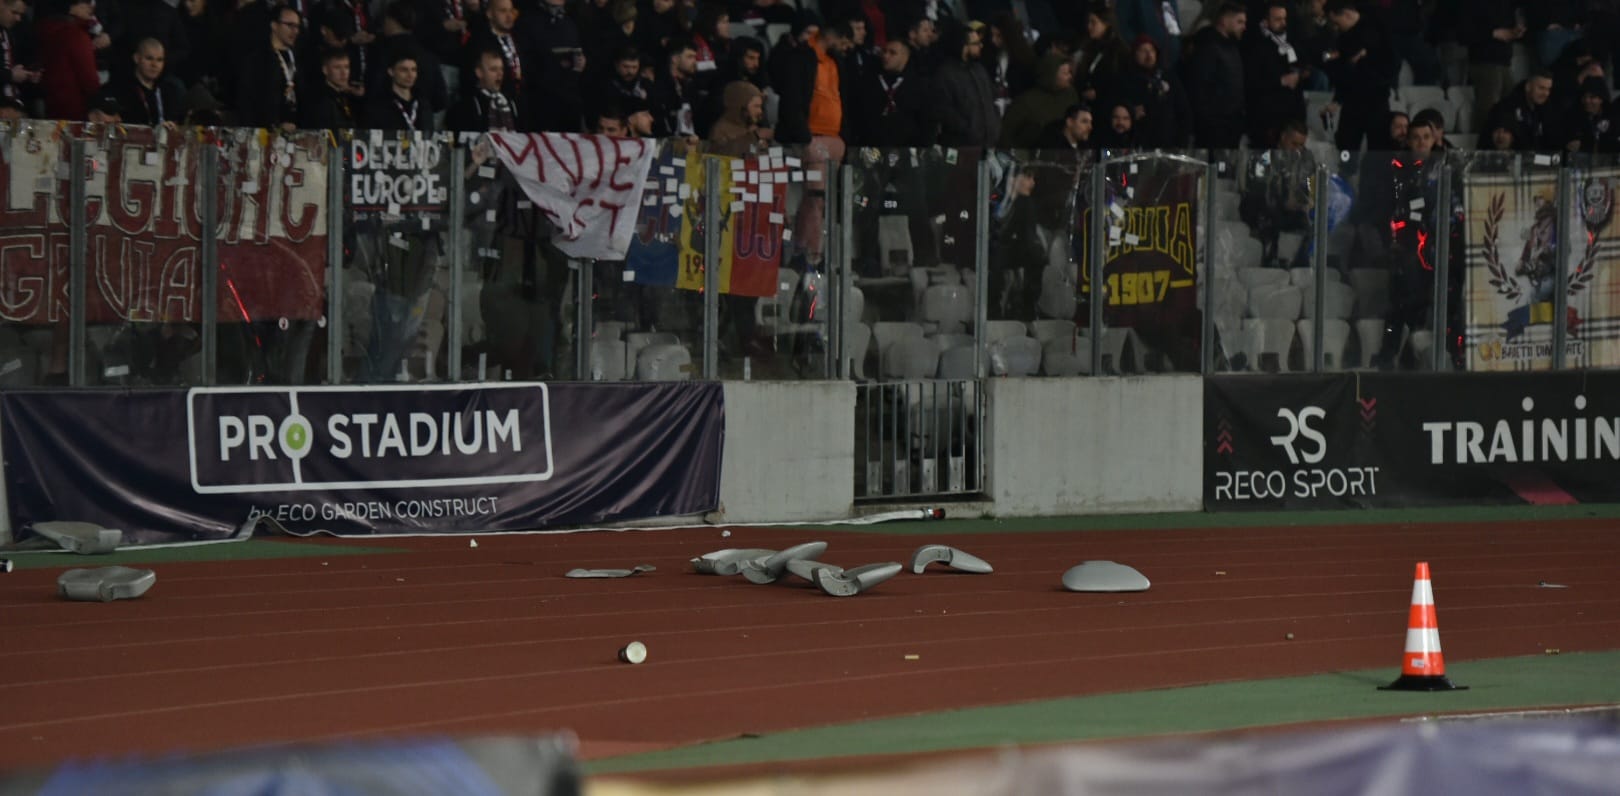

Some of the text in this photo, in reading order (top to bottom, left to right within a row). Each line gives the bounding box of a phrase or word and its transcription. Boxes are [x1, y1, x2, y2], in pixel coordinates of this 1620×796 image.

[351, 139, 441, 170] DEFEND
[351, 173, 441, 205] EUROPE
[0, 234, 198, 323] GRUIA
[1107, 270, 1171, 306] 1907
[218, 408, 522, 462] PRO STADIUM
[1270, 405, 1327, 465] RS
[1215, 466, 1380, 500] RECO SPORT
[275, 503, 316, 521] ECO
[320, 501, 392, 520] GARDEN
[394, 496, 499, 519] CONSTRUCT
